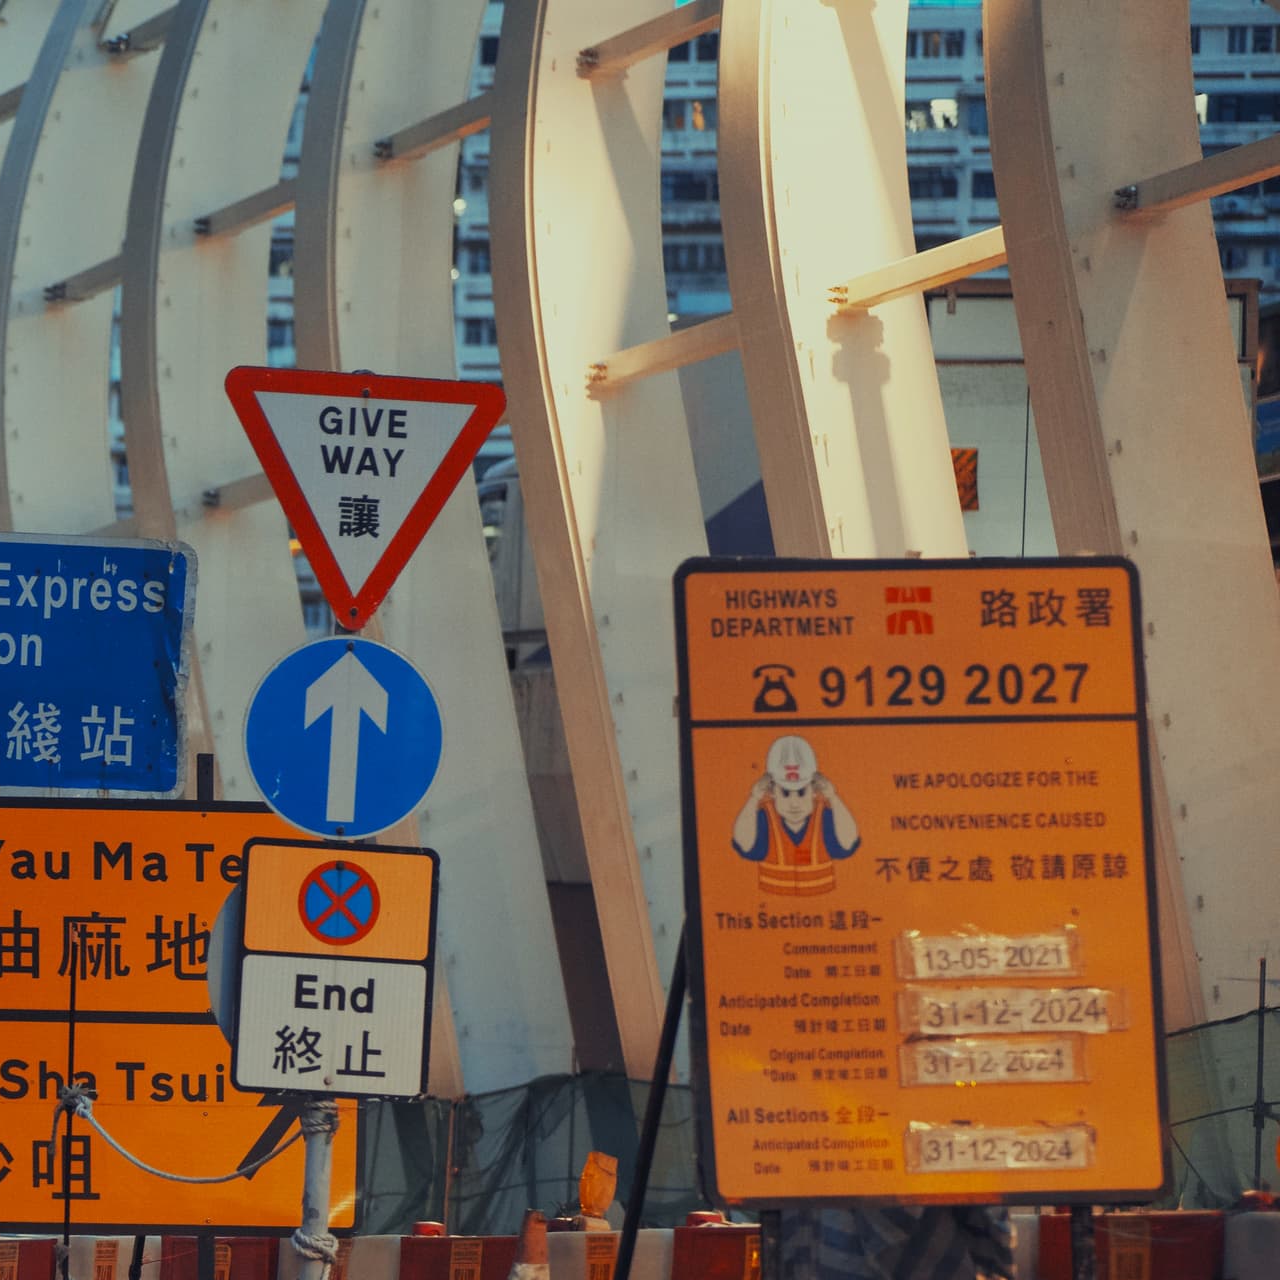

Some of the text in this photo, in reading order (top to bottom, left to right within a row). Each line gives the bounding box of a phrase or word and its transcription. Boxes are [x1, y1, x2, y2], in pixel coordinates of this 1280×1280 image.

[319, 406, 408, 439] GIVE
[320, 445, 405, 478] WAY
[338, 494, 380, 538] 讓
[725, 589, 837, 609] HIGHWAYS
[980, 588, 1114, 630] 路政署
[711, 616, 854, 638] DEPARTMENT
[819, 663, 1089, 708] 9129 2027
[894, 770, 1099, 790] WE APOLOGIZE FOR THE
[891, 812, 1107, 832] INCONVENIENCE CAUSED
[93, 842, 167, 884] Ma
[185, 843, 242, 884] Te
[876, 854, 1129, 882] 不便之處 敬請原諒
[716, 911, 824, 929] This Section
[783, 965, 812, 979] Date
[294, 974, 375, 1014] End
[718, 992, 880, 1010] Anticipated Completion
[720, 1021, 751, 1036] Date
[273, 1026, 386, 1078] 終止
[769, 1046, 886, 1064] Original Completion
[115, 1062, 225, 1103] Tsui
[727, 1106, 830, 1124] All Sections
